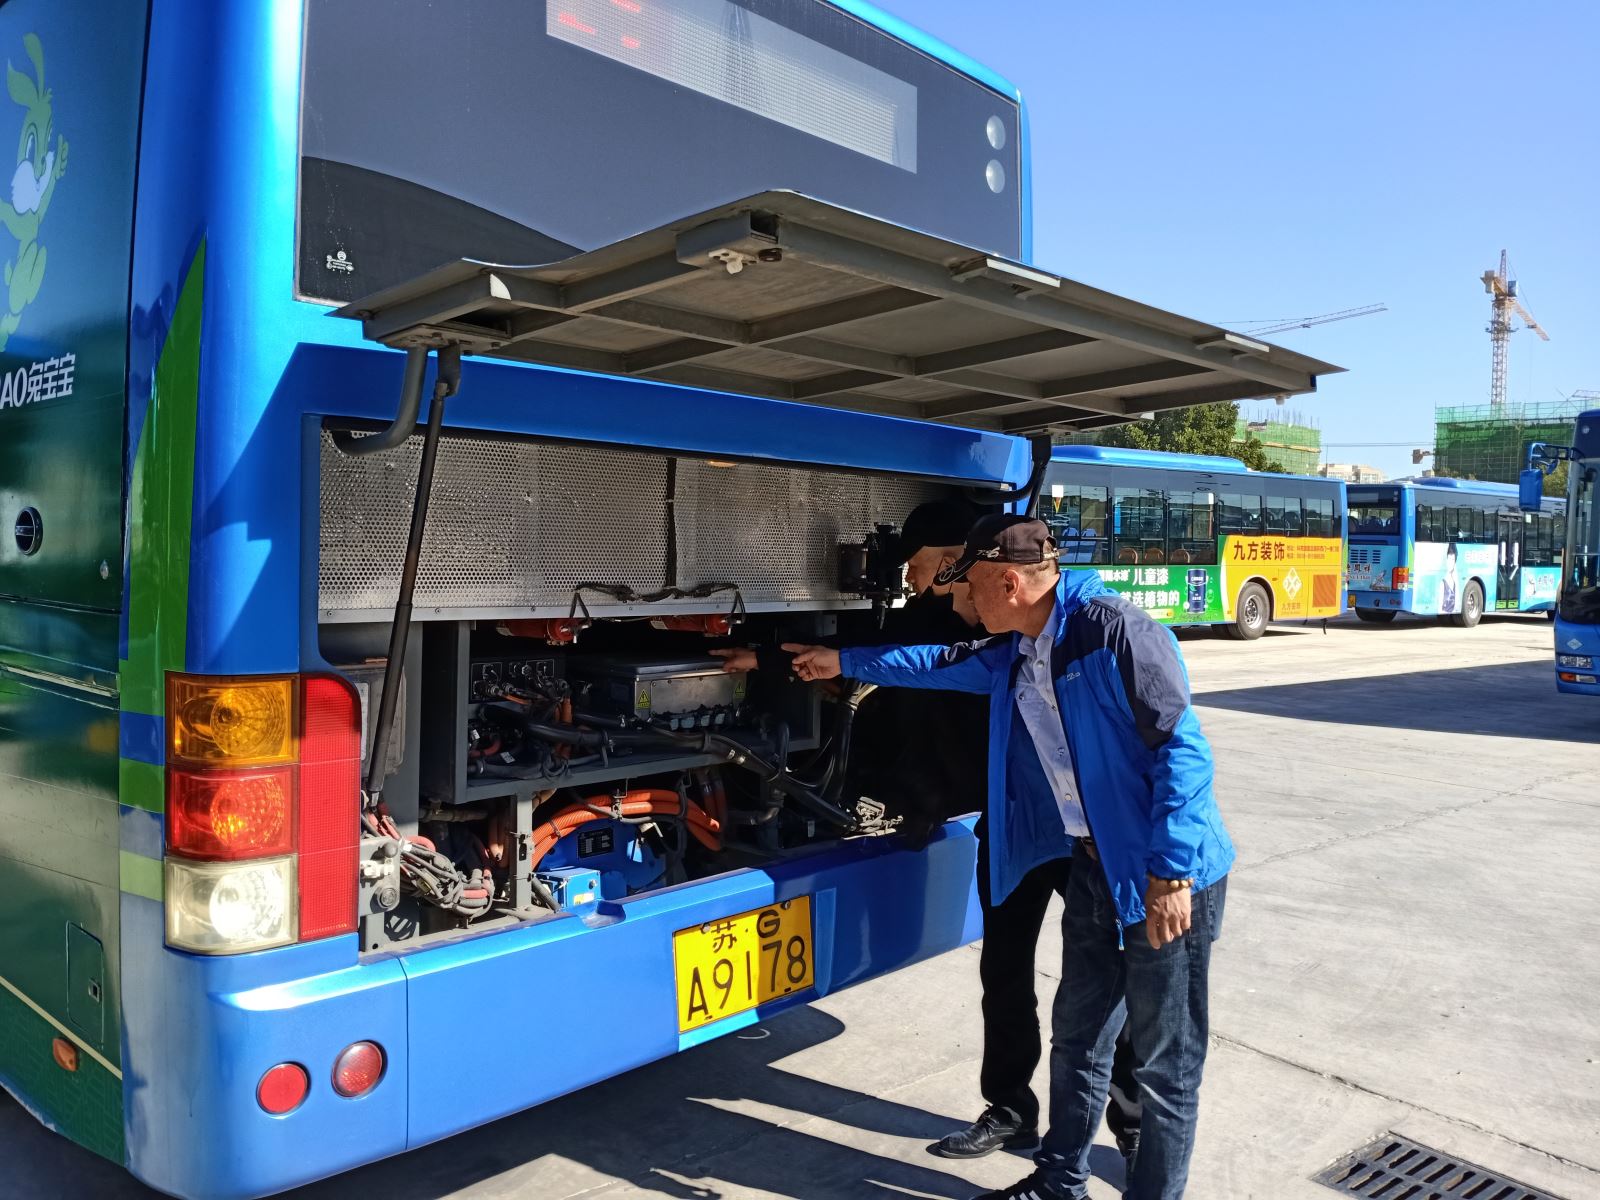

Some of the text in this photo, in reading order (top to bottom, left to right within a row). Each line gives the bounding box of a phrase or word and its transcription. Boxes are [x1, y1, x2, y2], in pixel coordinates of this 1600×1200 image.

[1233, 540, 1286, 562] 九方装饰
[1132, 568, 1169, 586] 儿童漆
[687, 935, 807, 1022] A9178
